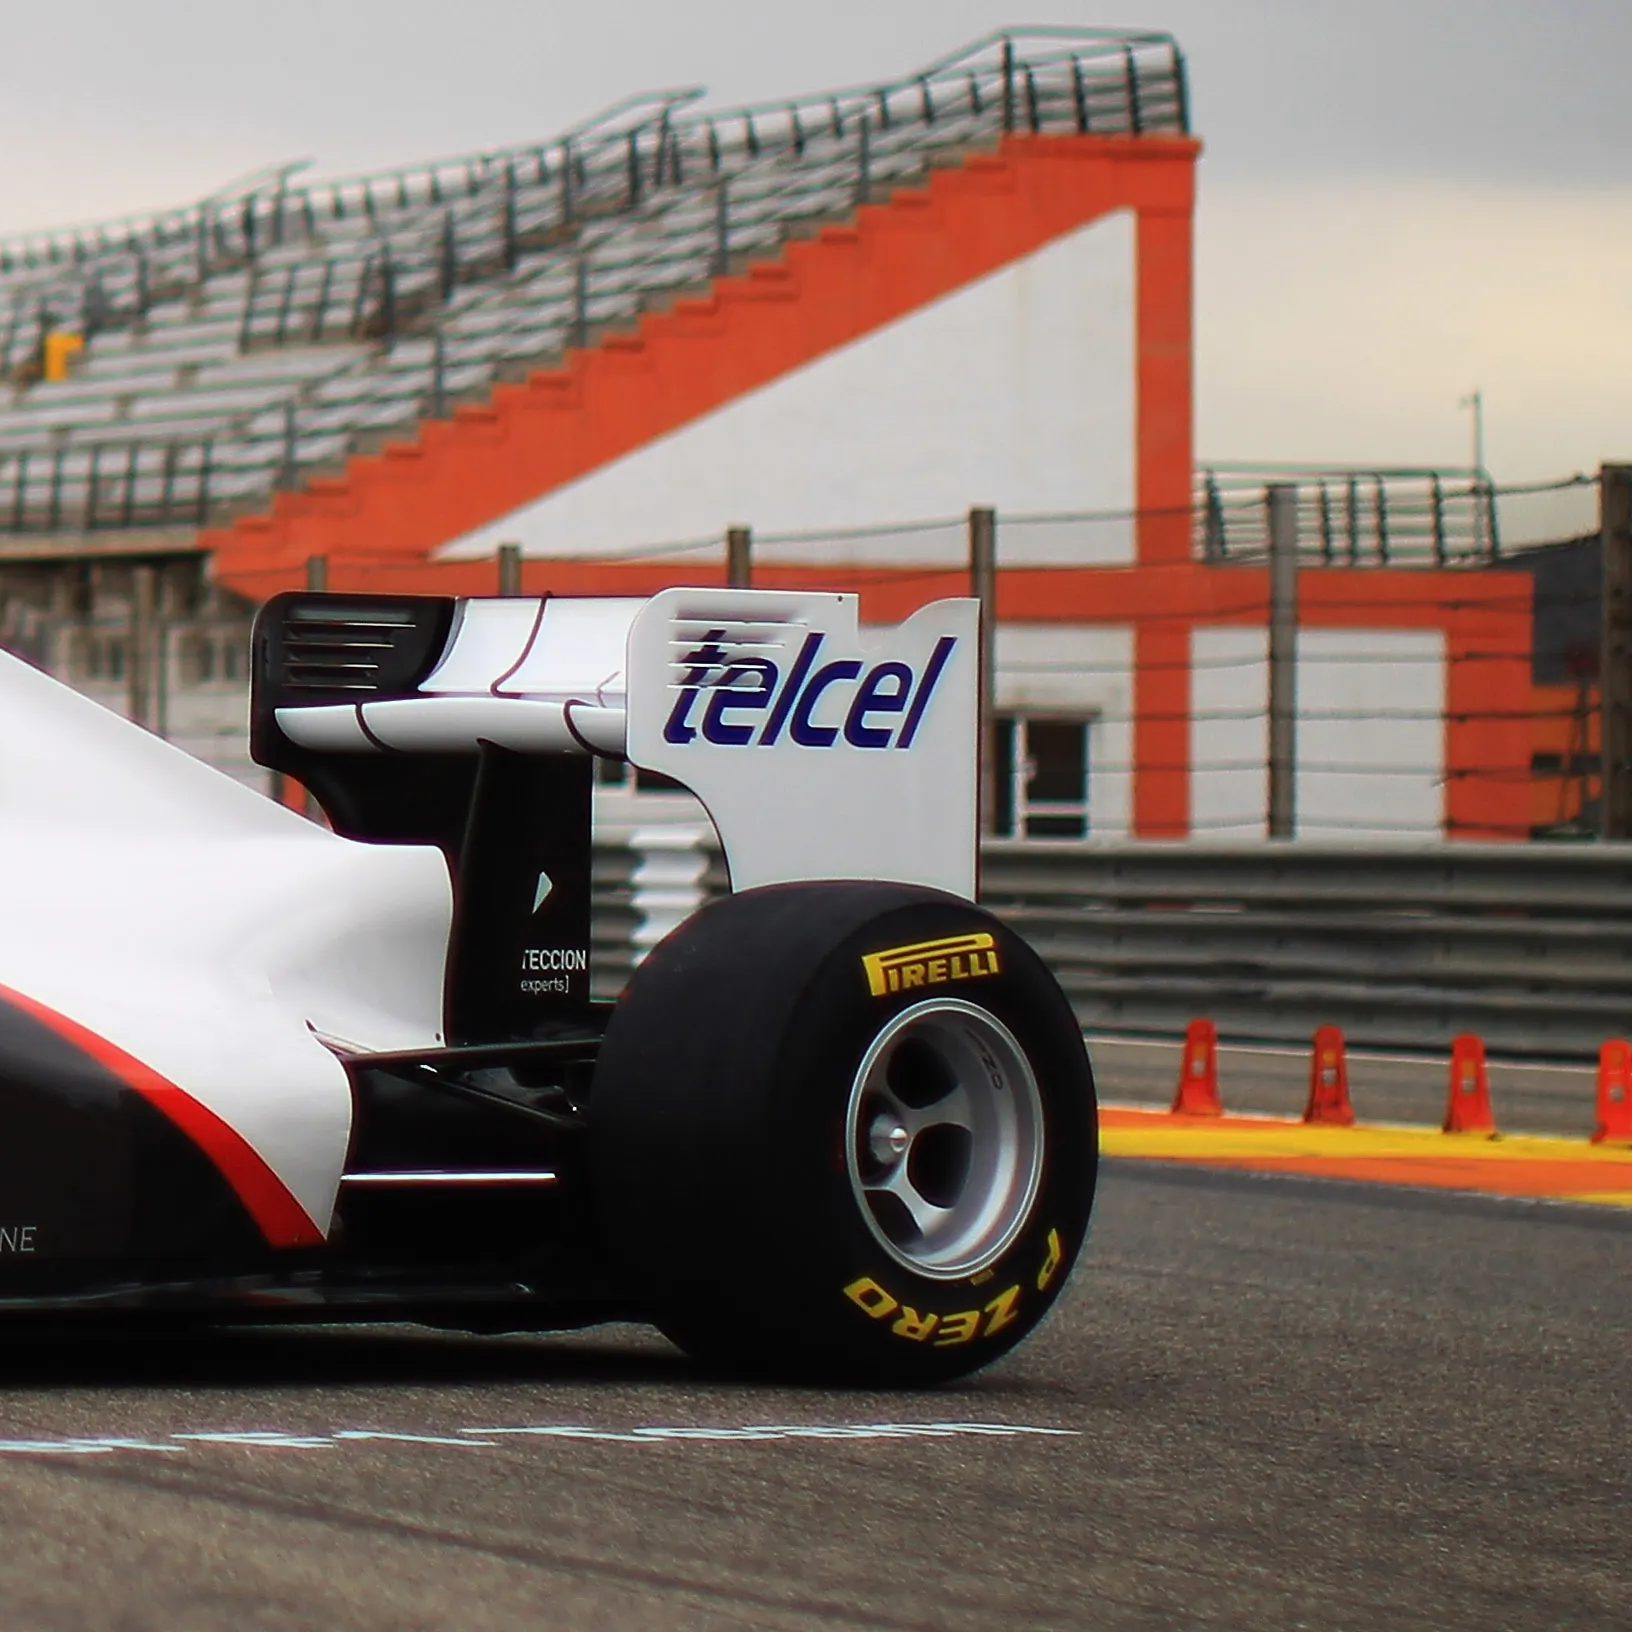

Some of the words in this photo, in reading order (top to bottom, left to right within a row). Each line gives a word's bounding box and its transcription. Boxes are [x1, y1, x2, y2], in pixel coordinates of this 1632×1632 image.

[663, 629, 958, 750] telcel
[861, 933, 1000, 997] PIRELLI
[843, 1276, 1021, 1348] ZERO
